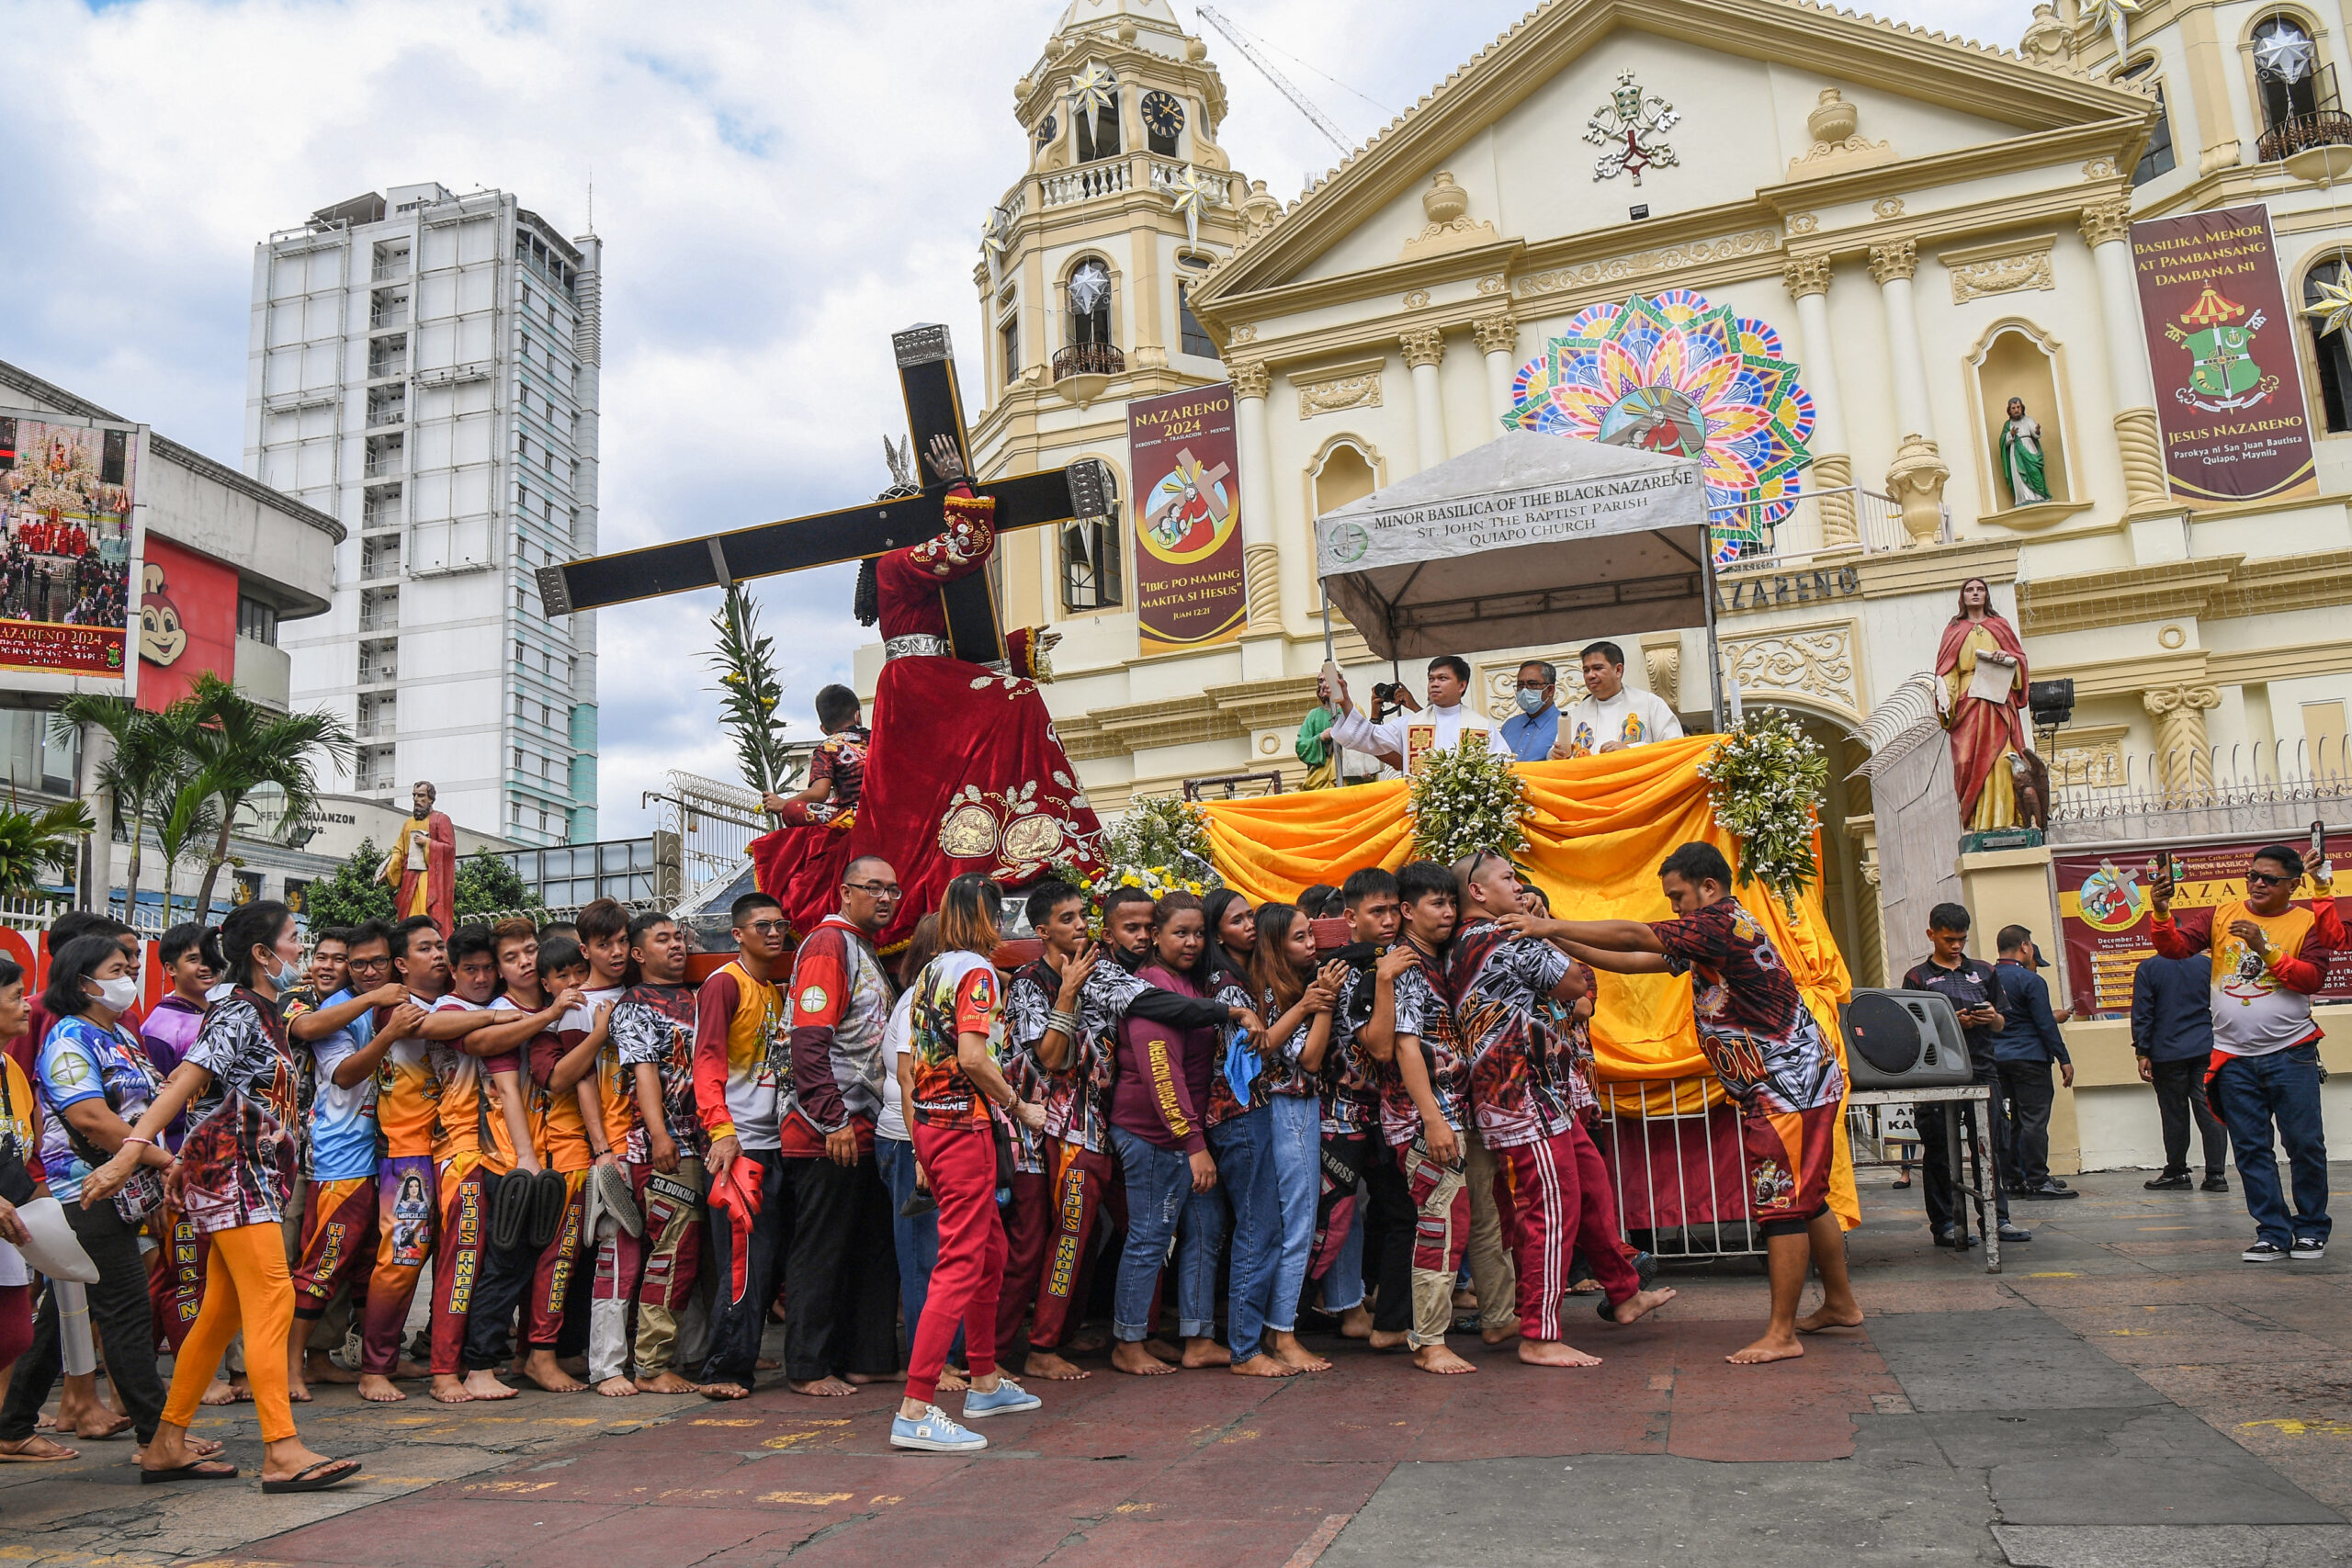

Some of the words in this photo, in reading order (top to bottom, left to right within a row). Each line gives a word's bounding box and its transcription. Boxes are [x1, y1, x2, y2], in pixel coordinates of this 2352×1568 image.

[2134, 235, 2201, 255] BASILIKA
[2205, 225, 2264, 243] MENOR
[2138, 259, 2155, 272] AT
[2160, 242, 2267, 268] PAMBANSANG
[2155, 265, 2234, 287] DAMBANA
[2237, 262, 2256, 274] NI
[1135, 399, 1229, 428] NAZARENO
[1164, 419, 1201, 437] 2024
[1135, 439, 1161, 448] DEBOSYON
[1170, 432, 1202, 441] TRASLACION
[2168, 428, 2210, 446] JESUS
[2213, 416, 2302, 437] NAZARENO
[2174, 448, 2209, 459] Parokya
[2212, 446, 2221, 454] ni
[2223, 444, 2240, 452] San
[2244, 441, 2263, 451] Juan
[2267, 435, 2302, 446] Bautista
[2202, 455, 2239, 465] Quiapo,
[2242, 448, 2278, 460] Maynila
[1374, 512, 1424, 529] MINOR
[1428, 501, 1495, 521] BASILICA
[1498, 497, 1516, 511] OF
[1520, 491, 1552, 507] THE
[1555, 485, 1606, 502] BLACK
[1608, 471, 1693, 496] NAZARENE
[1417, 527, 1440, 538] ST.
[1444, 521, 1484, 536] JOHN
[1488, 515, 1521, 528] THE
[1525, 506, 1588, 524] BAPTIST
[1593, 497, 1648, 514] PARISH
[1470, 528, 1527, 547] QUIAPO
[1531, 518, 1596, 536] CHURCH
[1171, 577, 1188, 588] PO
[1191, 569, 1240, 585] NAMING
[1140, 594, 1185, 609] MAKITA
[1188, 592, 1197, 602] SI
[1173, 611, 1192, 621] JUAN
[1193, 607, 1211, 616] 12:21
[71, 630, 103, 646] 2024
[305, 811, 356, 825] GUANZON
[2216, 860, 2250, 868] BASILICA
[1320, 1147, 1355, 1183] R.BOSS
[651, 1178, 696, 1202] SR.DUKHA
[1062, 1168, 1084, 1232] HIJOS
[458, 1182, 480, 1245] HIJOS
[558, 1204, 582, 1258] HIJOS
[313, 1222, 346, 1280] HIJOS
[1048, 1235, 1078, 1297] ANPON
[448, 1249, 477, 1314] ANPON
